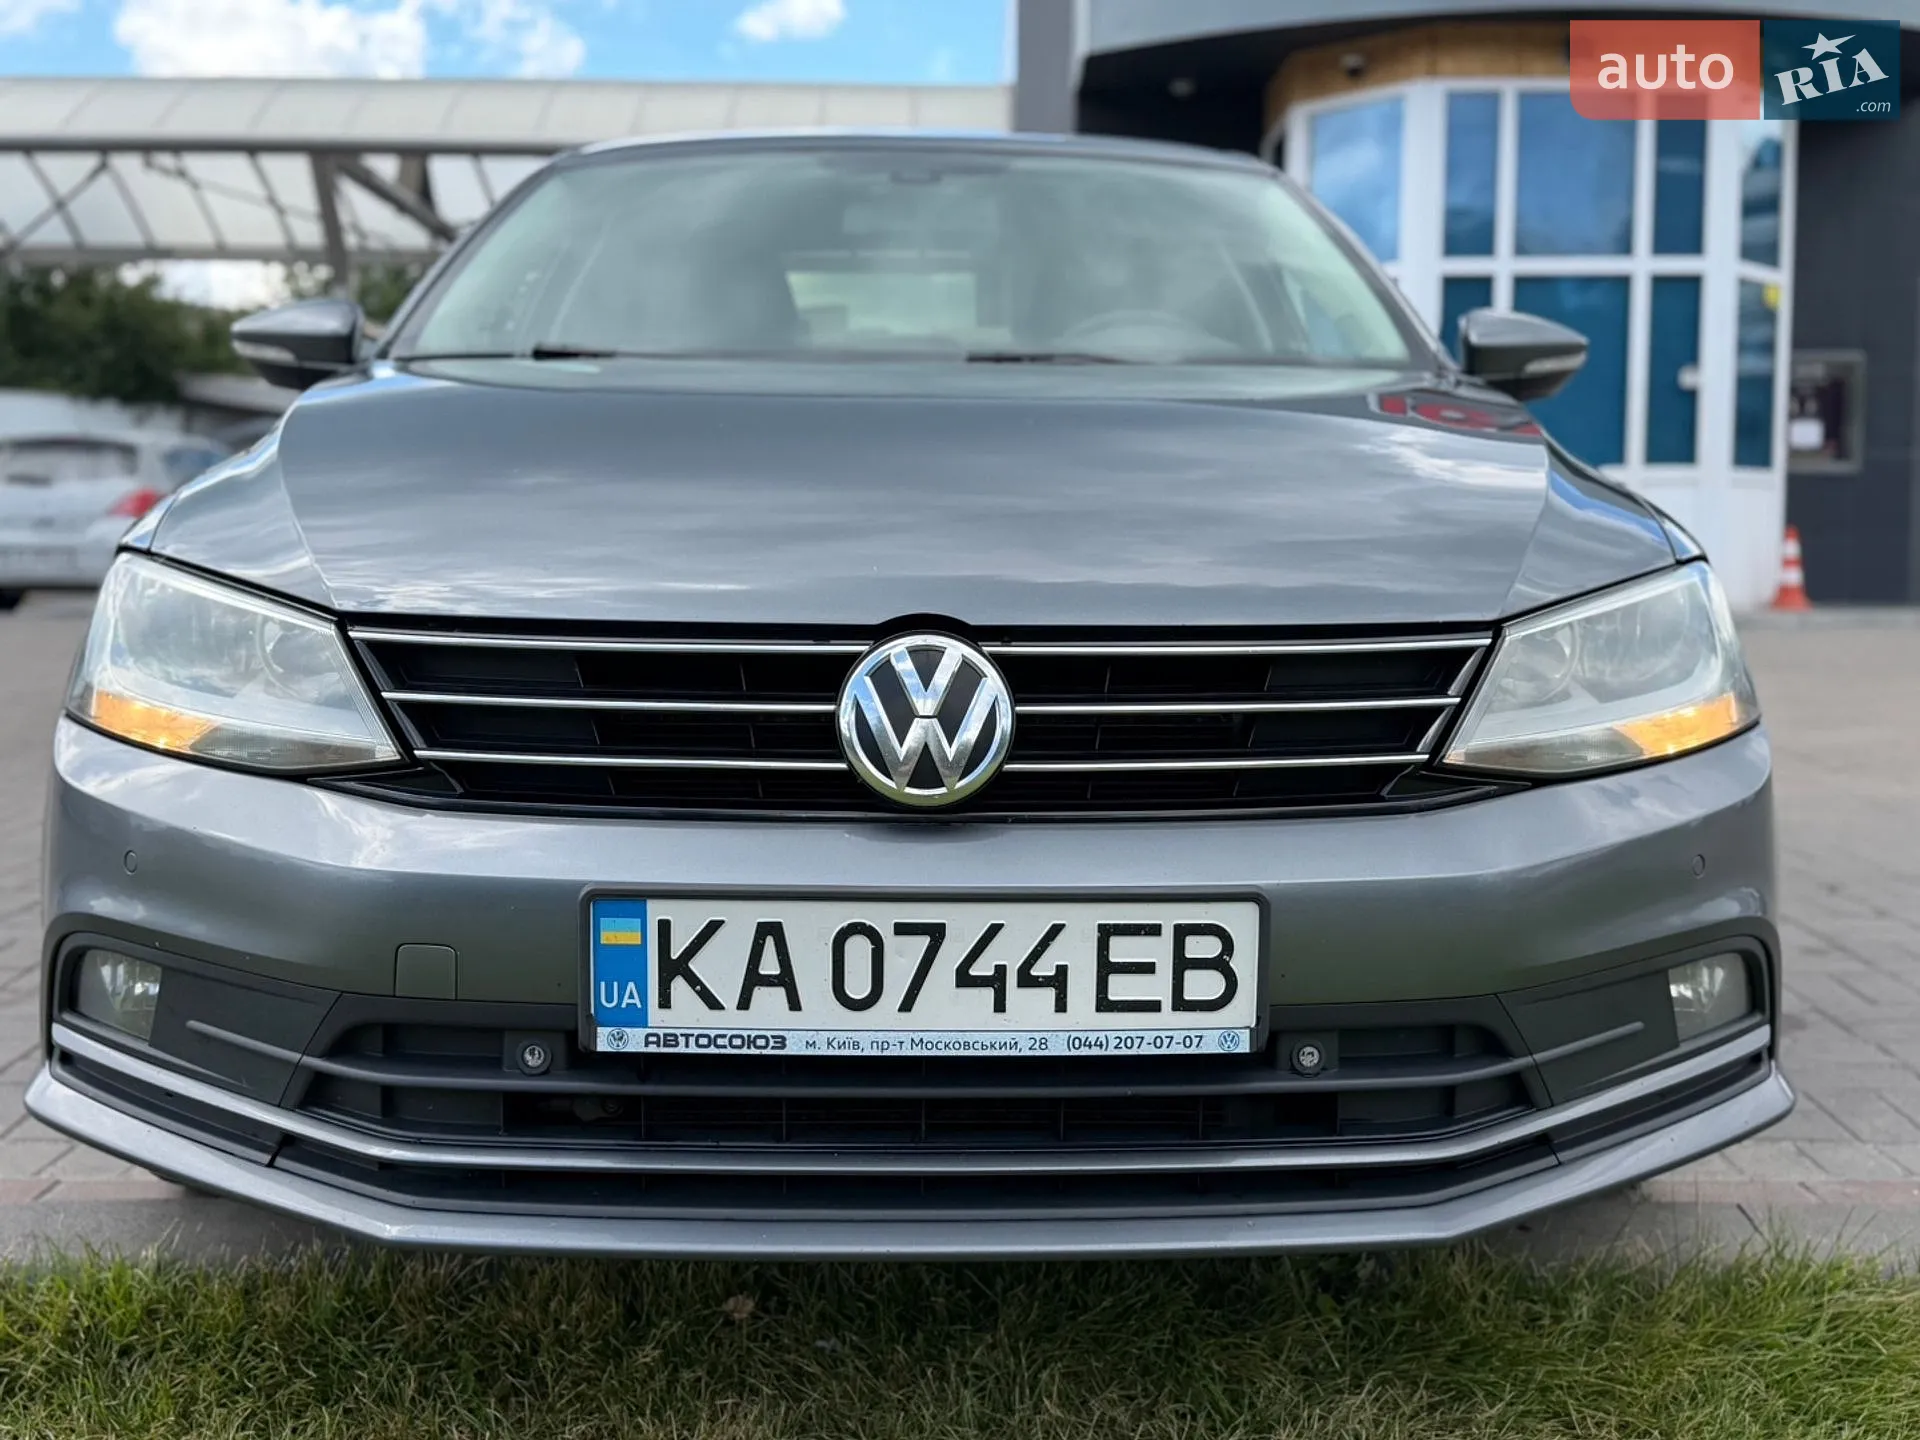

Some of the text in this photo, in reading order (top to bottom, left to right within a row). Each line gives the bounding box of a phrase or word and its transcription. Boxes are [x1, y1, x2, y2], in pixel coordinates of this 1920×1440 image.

[656, 917, 1239, 1014] KA 0744 EB
[600, 980, 643, 1009] UA
[643, 1032, 1204, 1053] АВТОСОЮЗ м. Київ, пр-т Московський, 28 (044) 207-07-07
